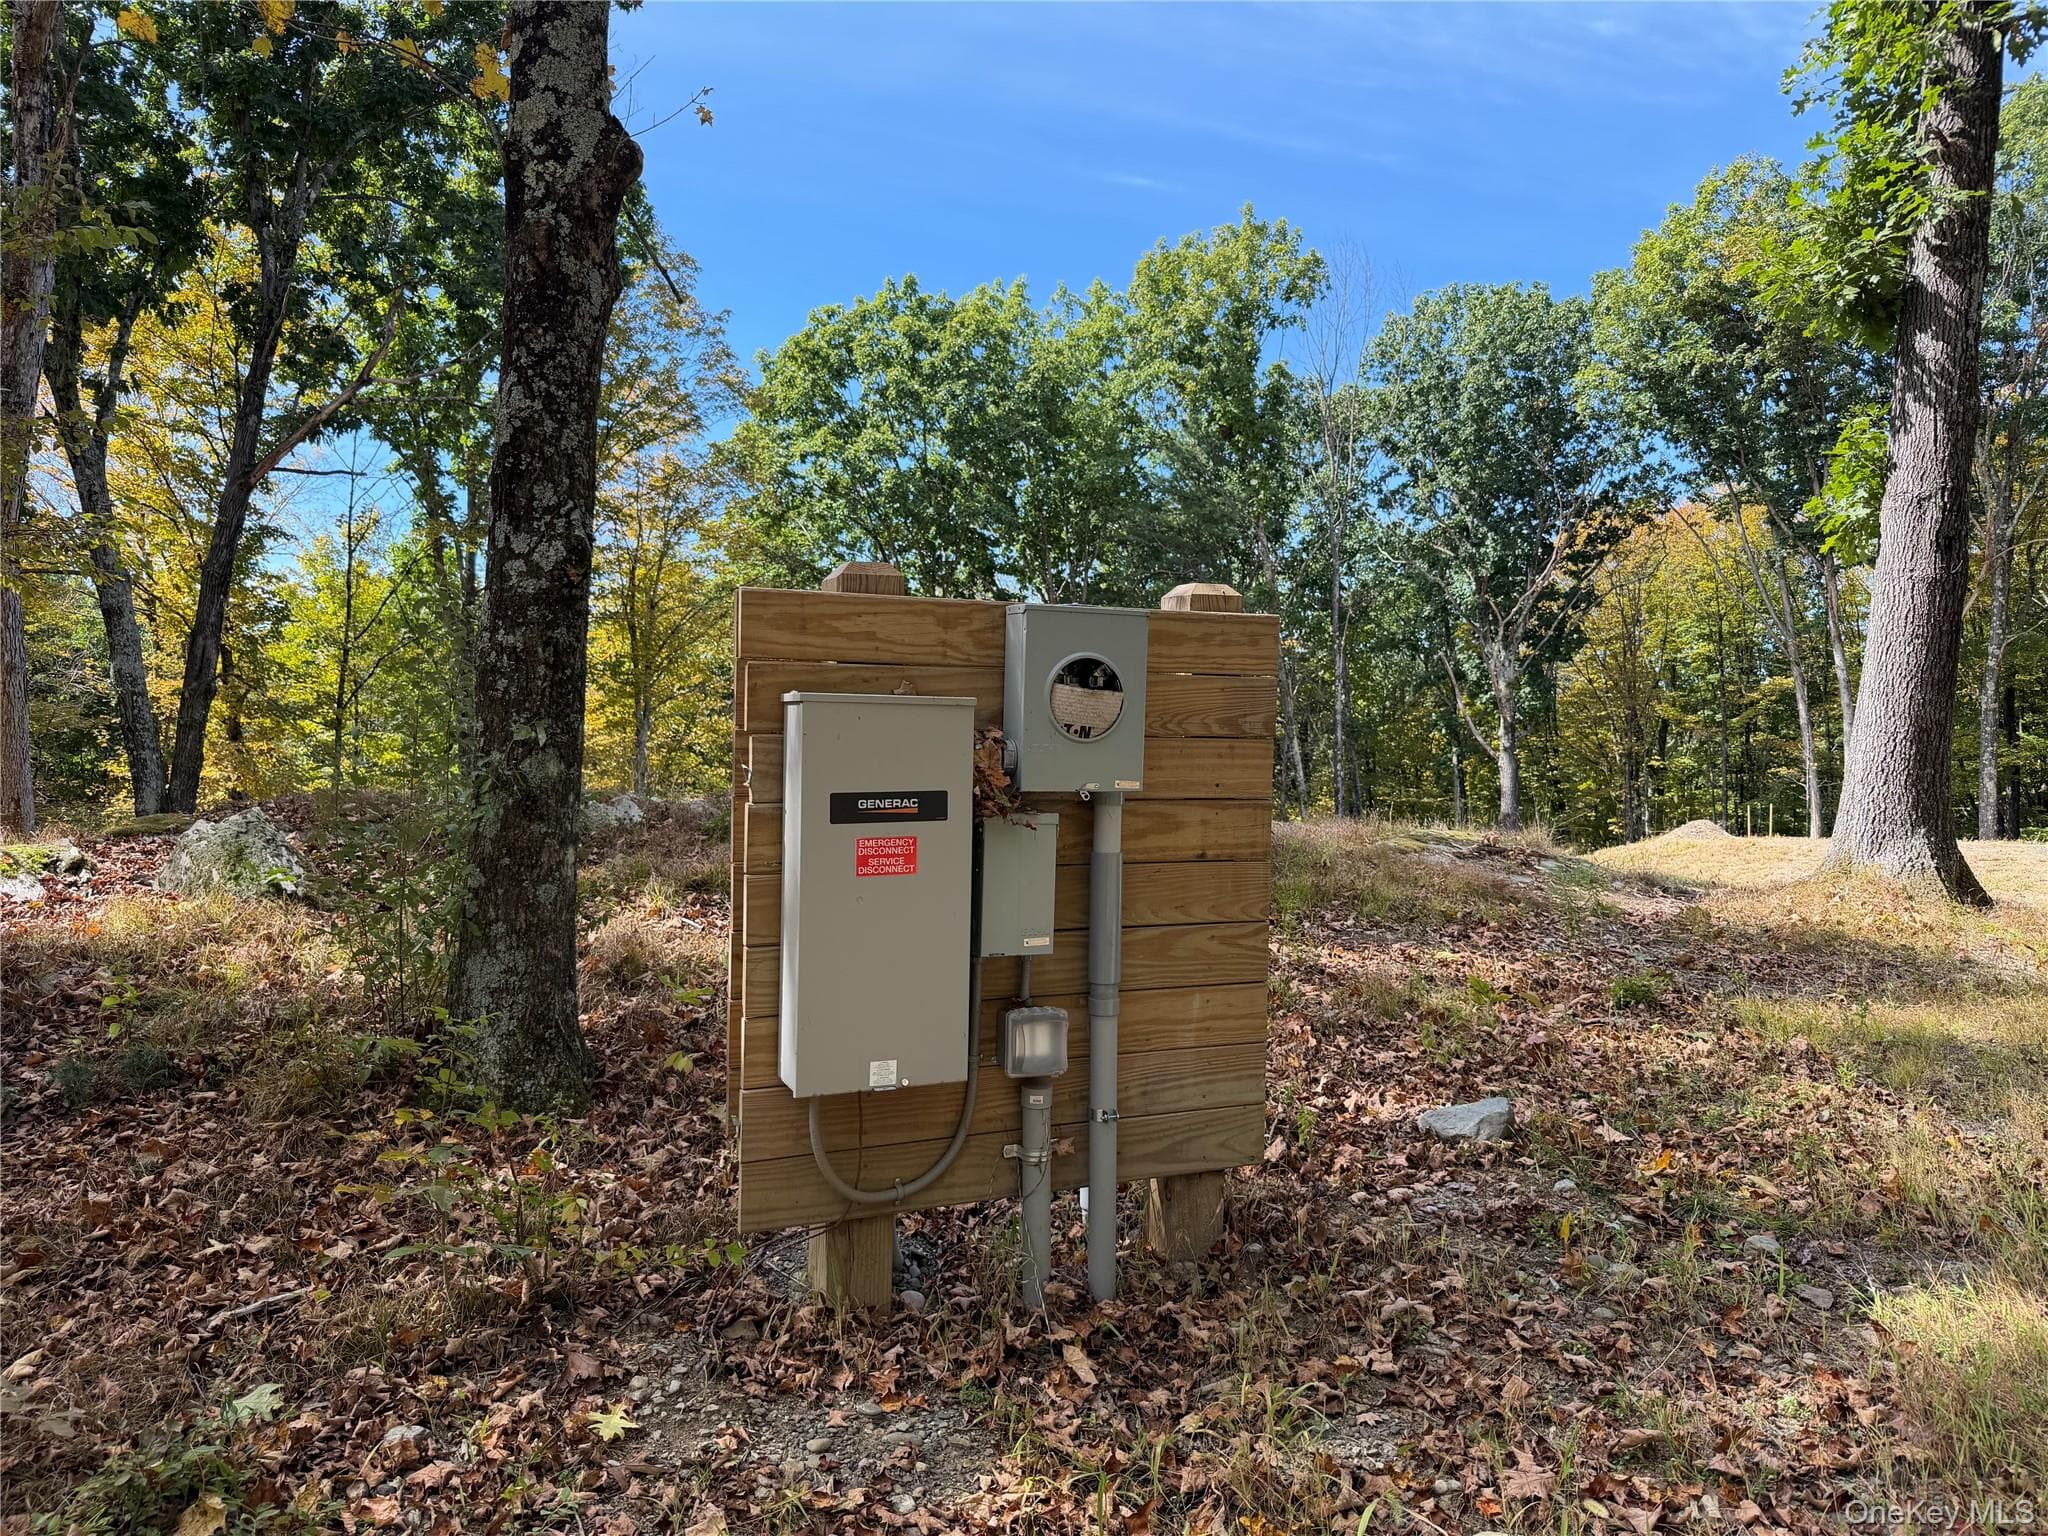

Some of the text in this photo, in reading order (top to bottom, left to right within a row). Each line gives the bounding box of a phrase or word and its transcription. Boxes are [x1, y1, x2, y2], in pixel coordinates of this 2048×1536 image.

[858, 798, 919, 809] GENERAC
[858, 838, 914, 848] EMERGENCY
[858, 846, 915, 856] DISCONNECT
[868, 857, 905, 866] SERVICE
[858, 864, 915, 875] DISCONNECT
